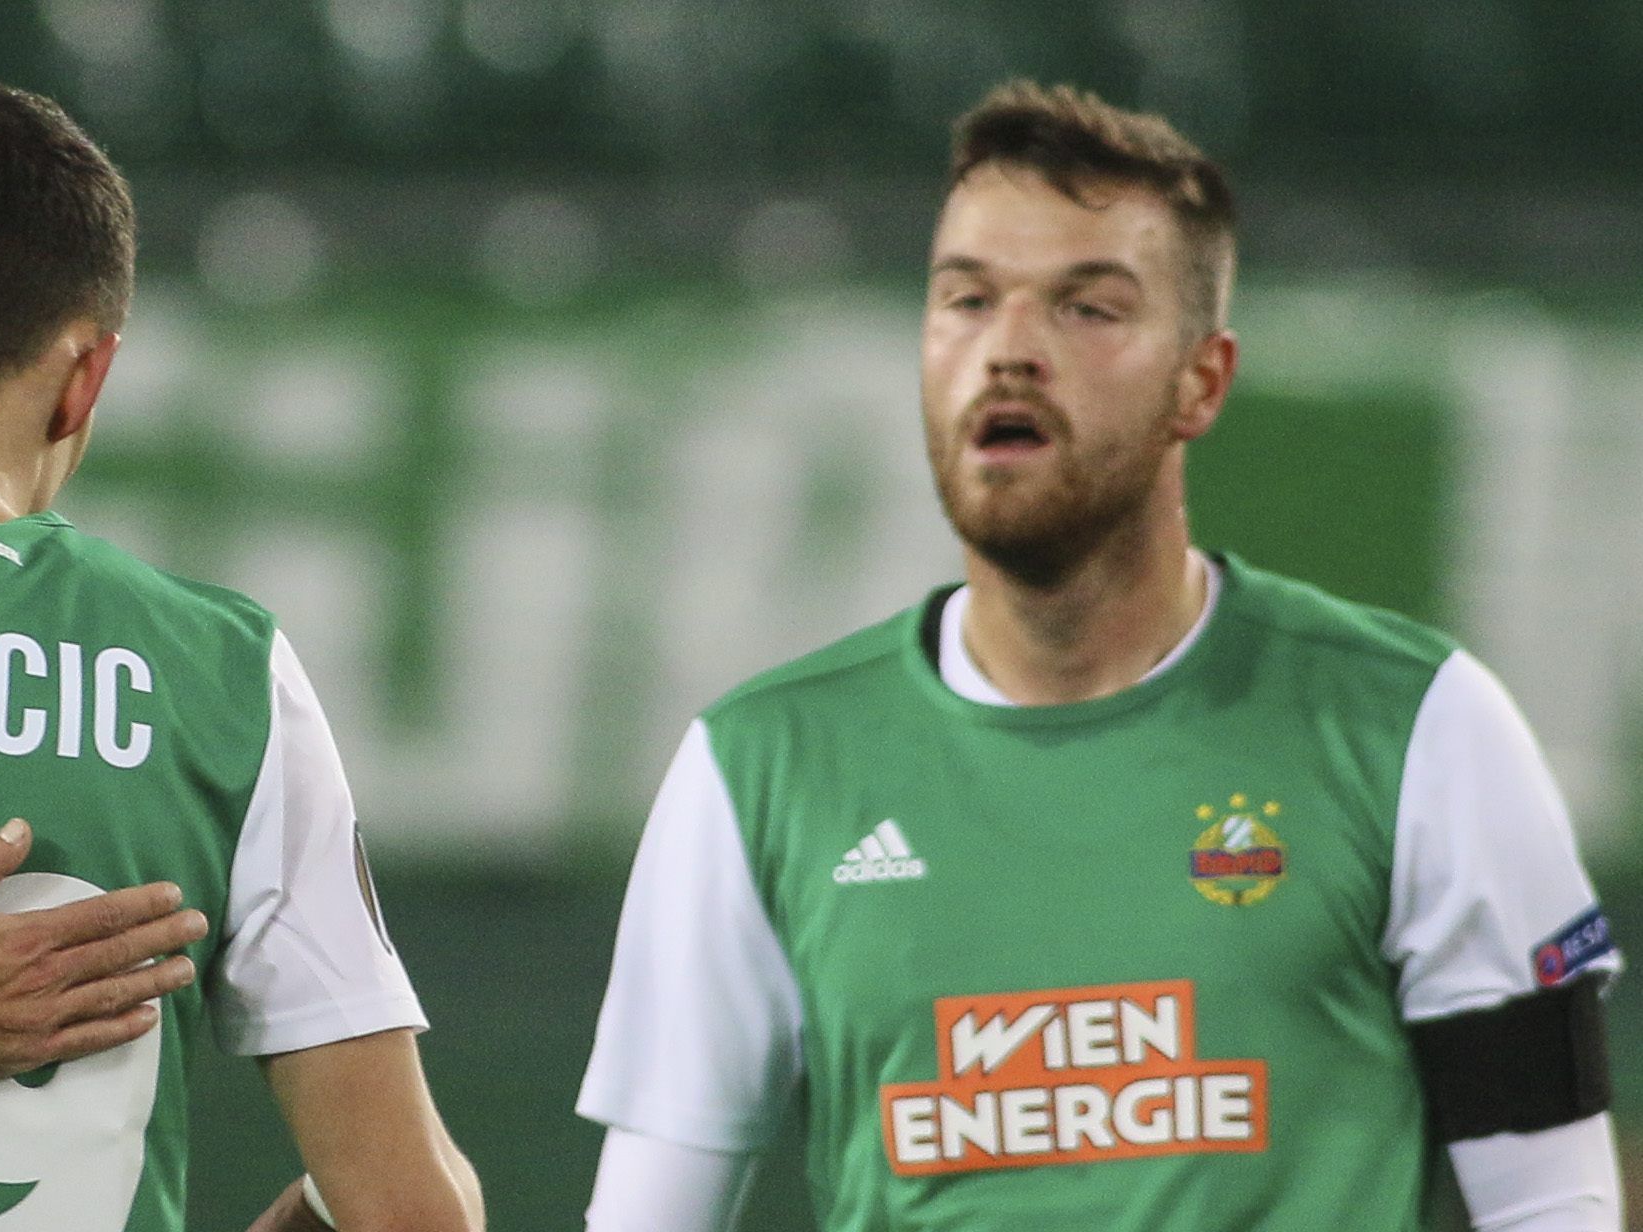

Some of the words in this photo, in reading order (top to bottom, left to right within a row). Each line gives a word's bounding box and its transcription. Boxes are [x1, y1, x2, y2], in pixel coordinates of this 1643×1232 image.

[833, 858, 926, 884] adidas
[950, 995, 1179, 1077] WIEN
[892, 1073, 1252, 1164] ENERGIE
